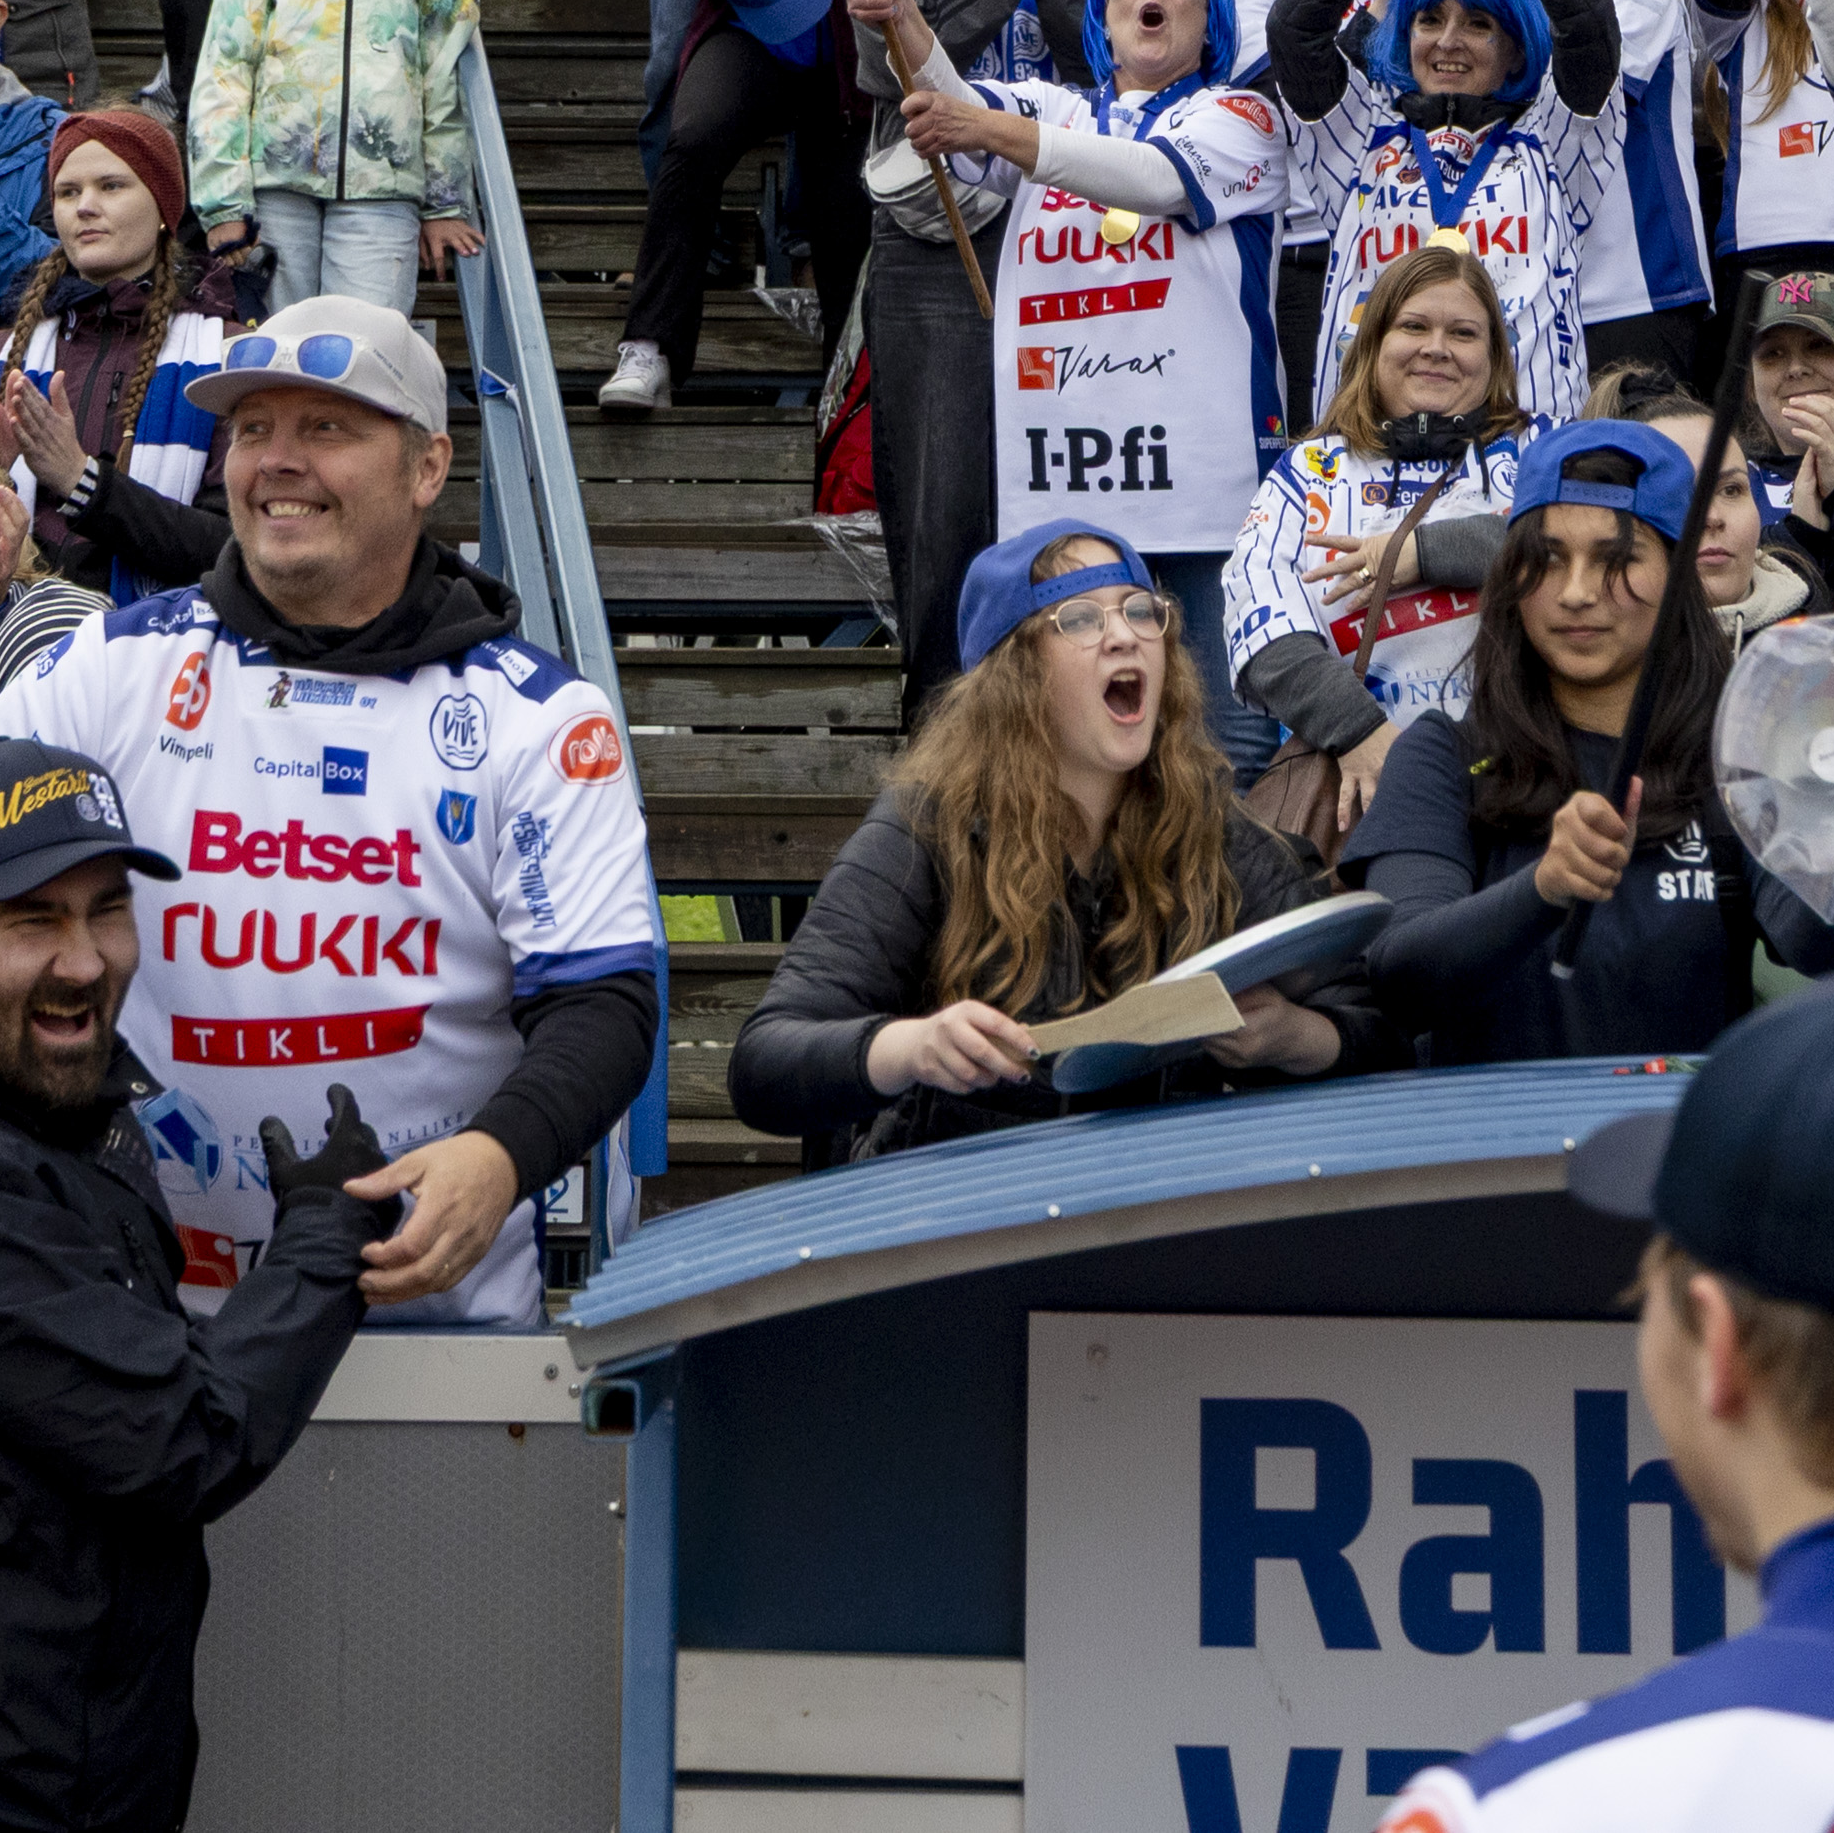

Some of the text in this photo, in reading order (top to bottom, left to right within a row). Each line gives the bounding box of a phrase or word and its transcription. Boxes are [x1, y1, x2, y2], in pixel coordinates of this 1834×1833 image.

[1777, 275, 1814, 305] NY
[1025, 423, 1174, 492] I-P.fi
[160, 735, 215, 763] Vimpeli
[443, 710, 479, 751] VIVE
[568, 725, 621, 770] rolls
[187, 809, 422, 888] Betset
